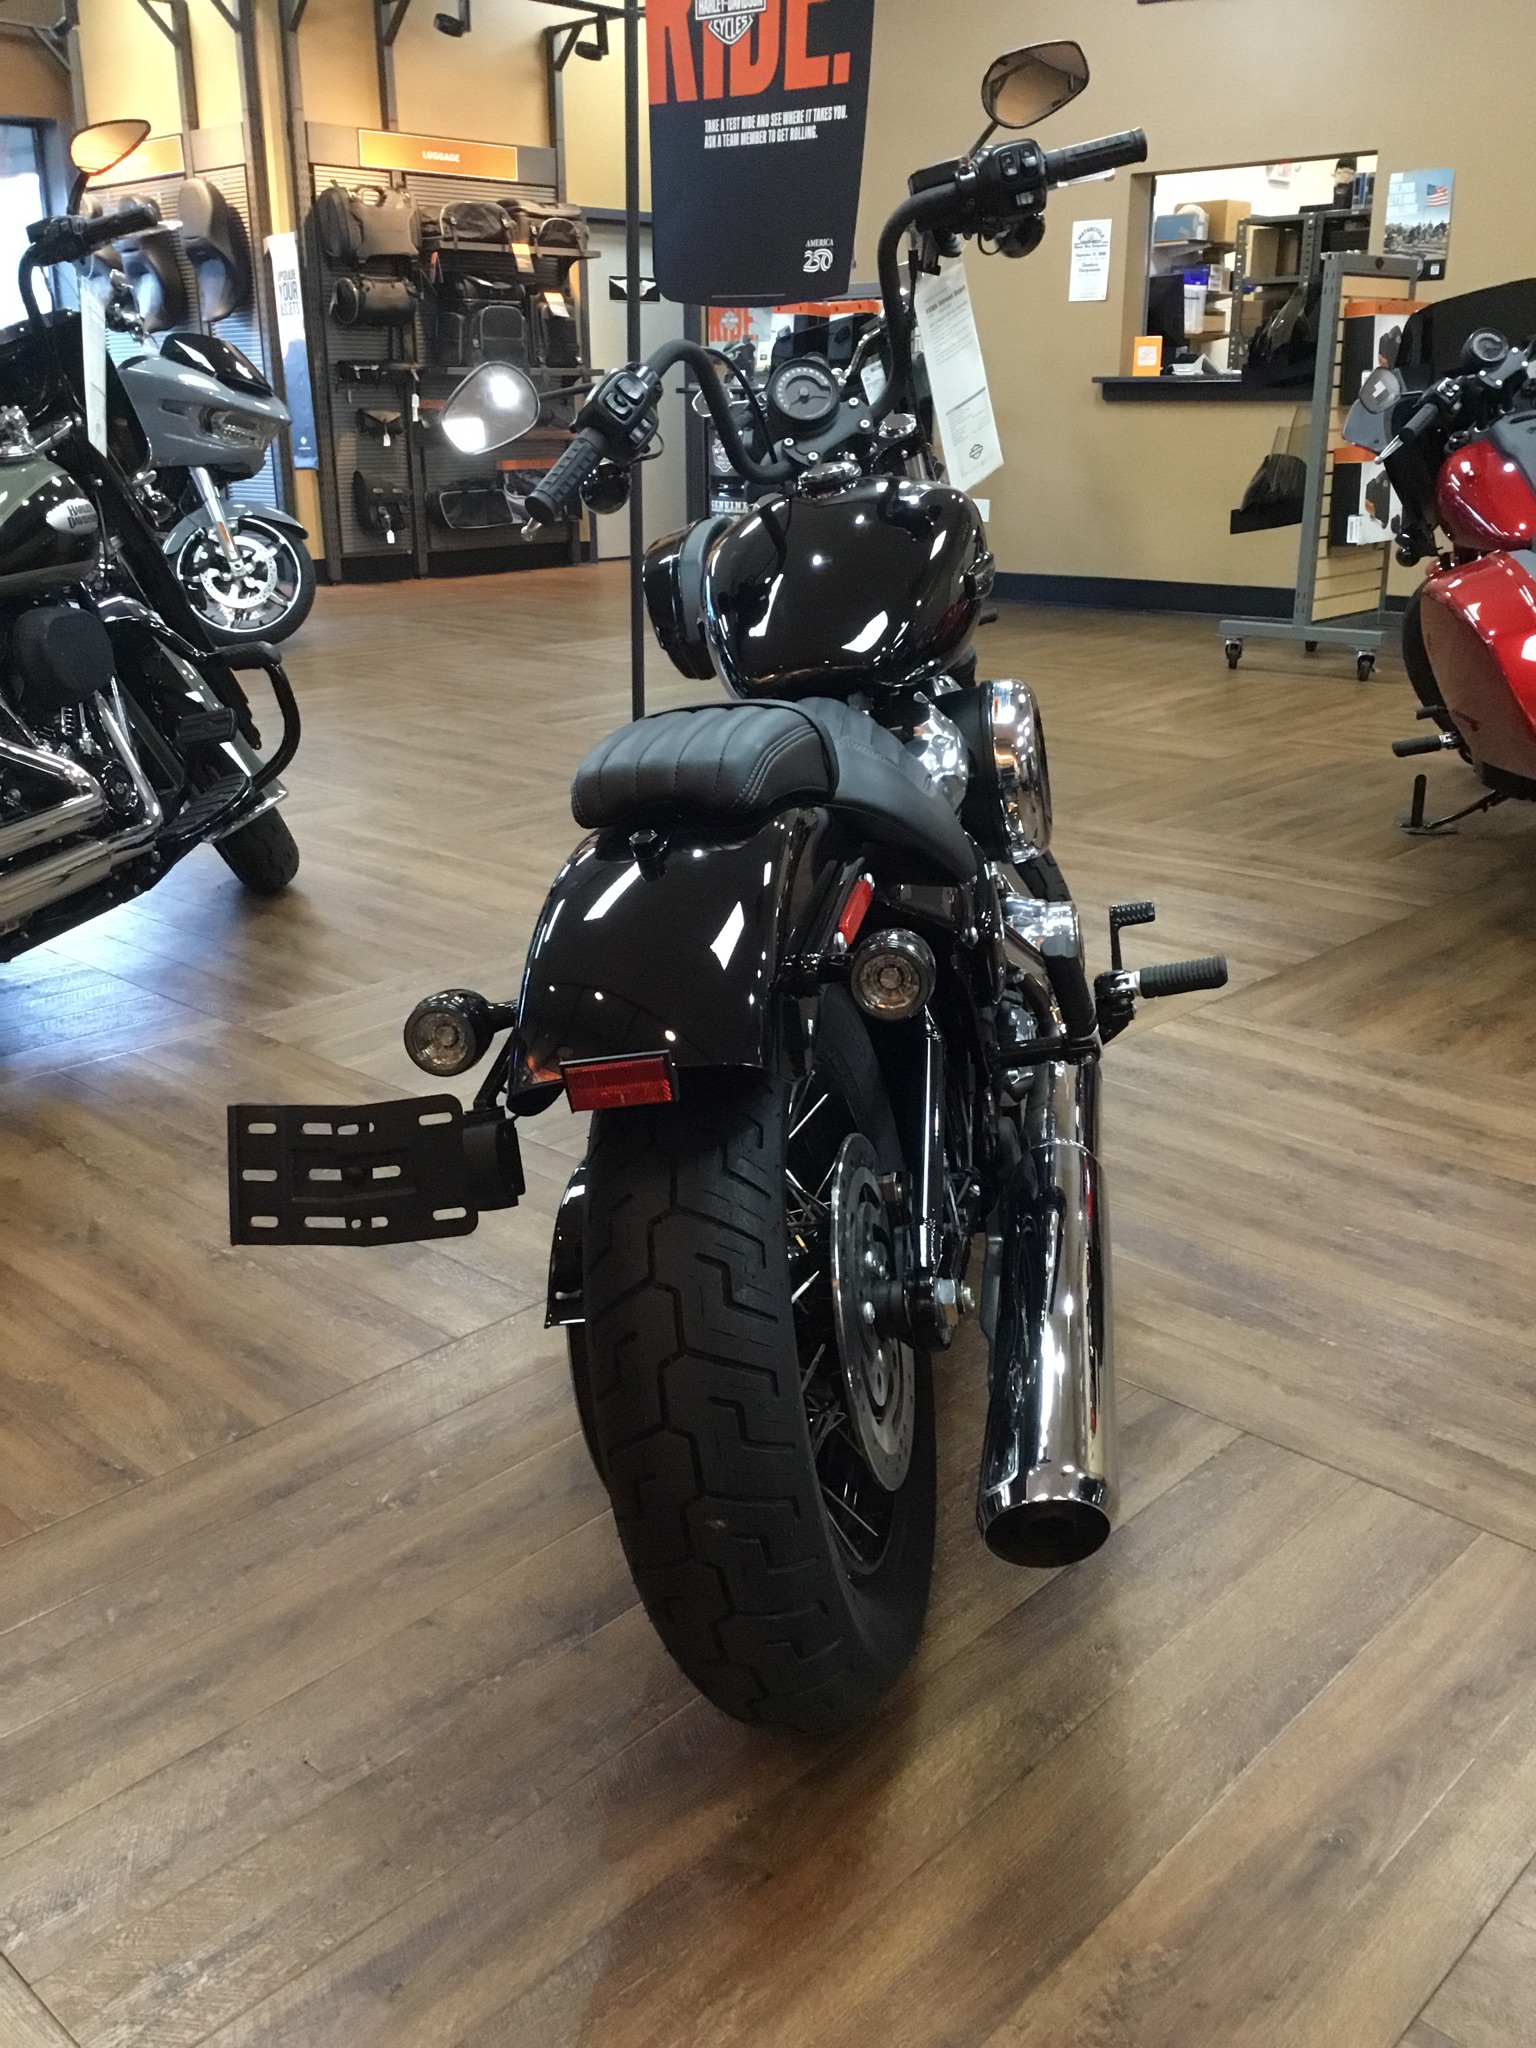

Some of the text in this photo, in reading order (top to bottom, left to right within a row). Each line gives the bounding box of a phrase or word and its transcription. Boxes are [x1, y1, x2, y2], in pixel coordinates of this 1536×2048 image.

[713, 15, 748, 39] CYCLES
[705, 119, 719, 133] TAKE
[726, 116, 741, 131] TEST
[741, 115, 756, 130] RIDE
[756, 113, 769, 128] AND
[771, 112, 782, 127] SEE
[783, 109, 804, 125] WHERE
[805, 109, 812, 123] IT
[813, 106, 832, 122] TAKES
[833, 104, 848, 120] YOU.
[704, 135, 717, 149] ASK
[723, 132, 739, 147] TEAM
[740, 130, 767, 146] MEMBER
[768, 129, 776, 143] TO
[777, 127, 789, 142] GET
[790, 125, 818, 141] ROLLING.
[422, 150, 460, 163] LUGGAGE
[805, 238, 834, 247] AMERICA
[803, 248, 833, 273] 250
[279, 281, 299, 301] YOUR
[711, 500, 748, 509] GENUINE
